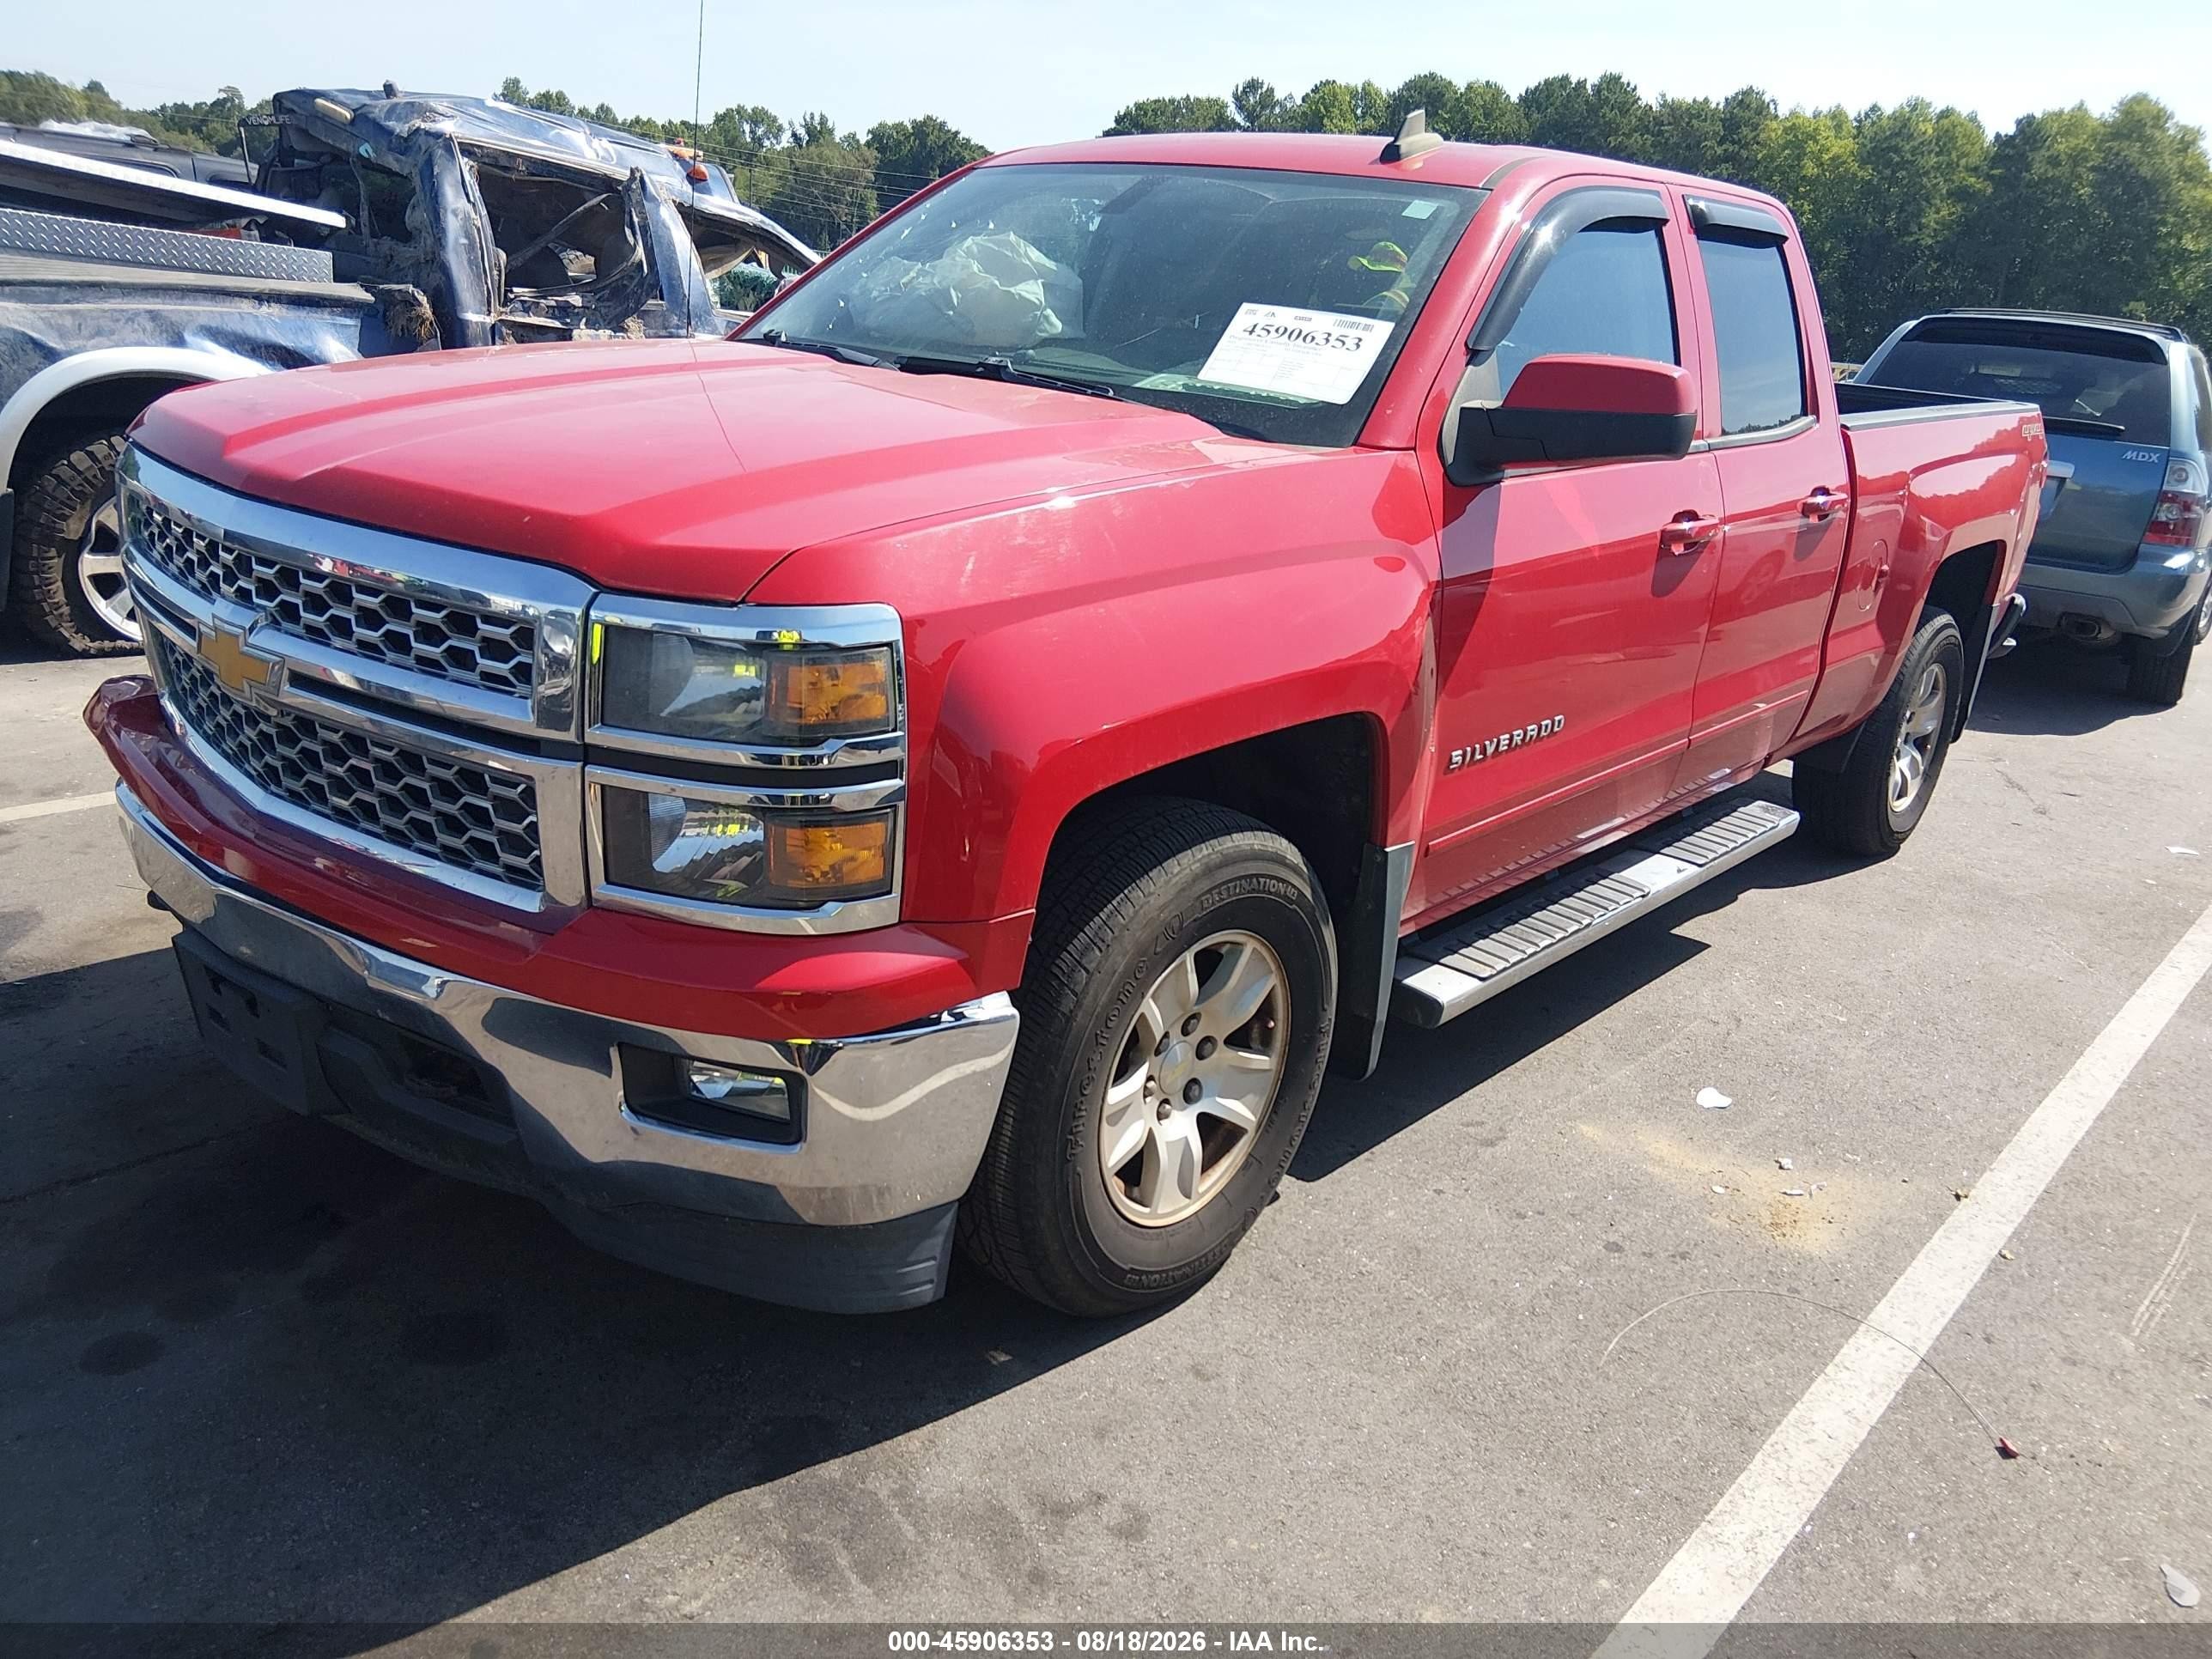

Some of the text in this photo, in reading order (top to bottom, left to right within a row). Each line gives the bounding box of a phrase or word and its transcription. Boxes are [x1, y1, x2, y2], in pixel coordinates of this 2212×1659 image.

[1243, 322, 1363, 352] 45906353
[2122, 450, 2160, 463] MDX
[1449, 714, 1565, 769] SILVERADO
